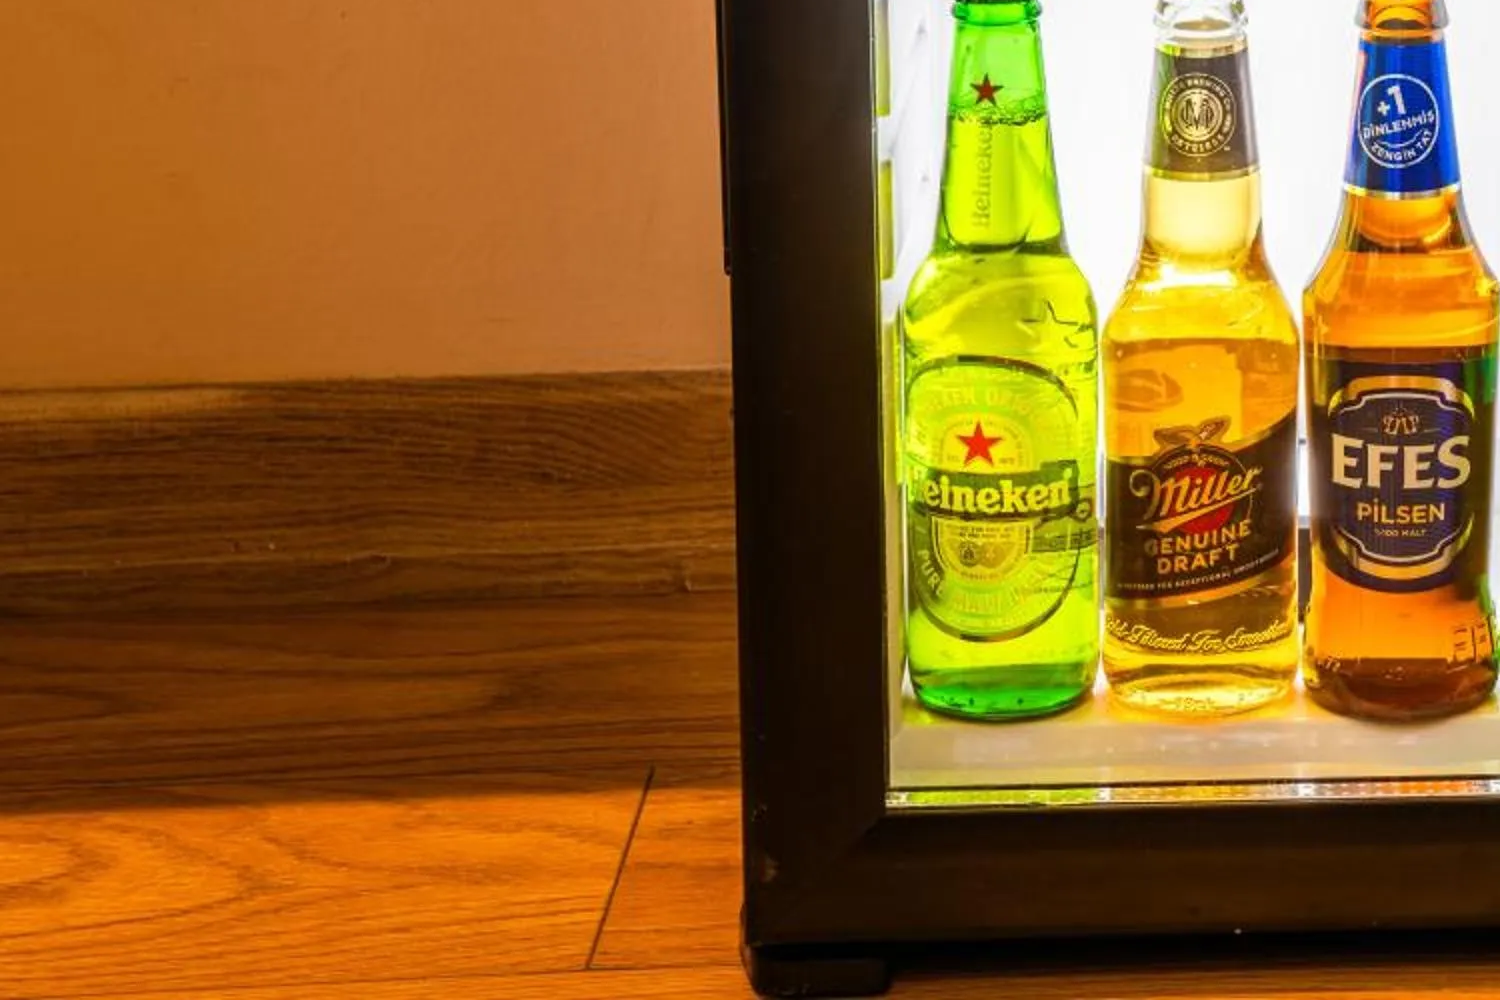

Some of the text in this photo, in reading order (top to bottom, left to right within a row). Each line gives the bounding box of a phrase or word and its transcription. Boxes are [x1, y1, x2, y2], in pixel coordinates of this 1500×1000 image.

[1331, 433, 1471, 489] EFES
[916, 471, 1071, 514] eineken
[1128, 466, 1263, 520] Miller
[1144, 519, 1252, 556] GENUINE
[1401, 528, 1426, 537] MALT
[1157, 545, 1239, 575] DRAFT
